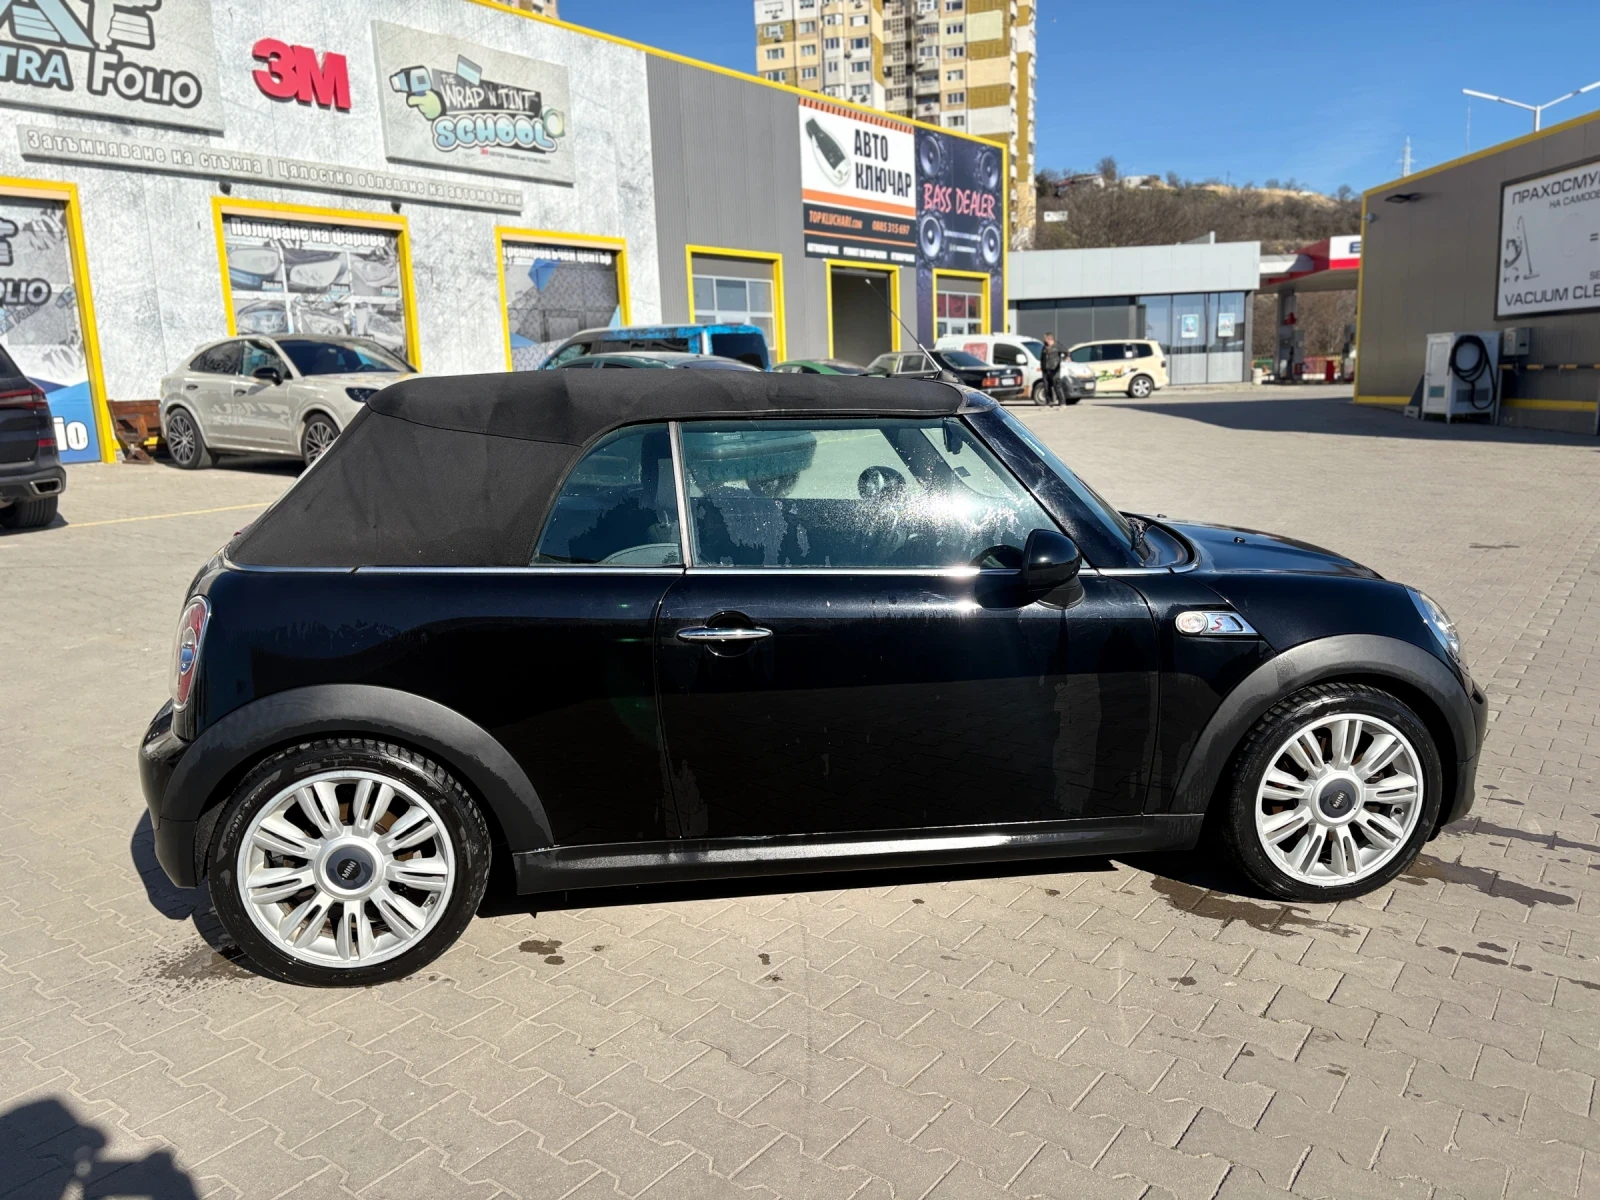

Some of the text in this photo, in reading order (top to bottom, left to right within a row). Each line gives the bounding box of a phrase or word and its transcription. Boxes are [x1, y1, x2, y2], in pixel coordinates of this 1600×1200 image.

[90, 50, 200, 106] FOLIO
[252, 38, 351, 109] 3M
[440, 74, 457, 85] THE
[440, 84, 485, 109] WRAP
[498, 88, 536, 112] TINT
[433, 115, 556, 151] SCHOOL
[854, 129, 888, 162] АВТО
[27, 130, 522, 206] Затъмняване на стъкла Цялостно облепяне на автомобили
[855, 162, 912, 198] КЛЮЧАР
[923, 183, 996, 219] BASS DEALER
[1512, 170, 1600, 206] ПРАХОСМУ
[1549, 199, 1561, 210] НА
[230, 216, 387, 249] Полиране на фарове
[1504, 287, 1569, 306] VACUUM
[1210, 616, 1224, 631] S
[1332, 792, 1345, 809] MINI
[342, 860, 357, 878] MINI
